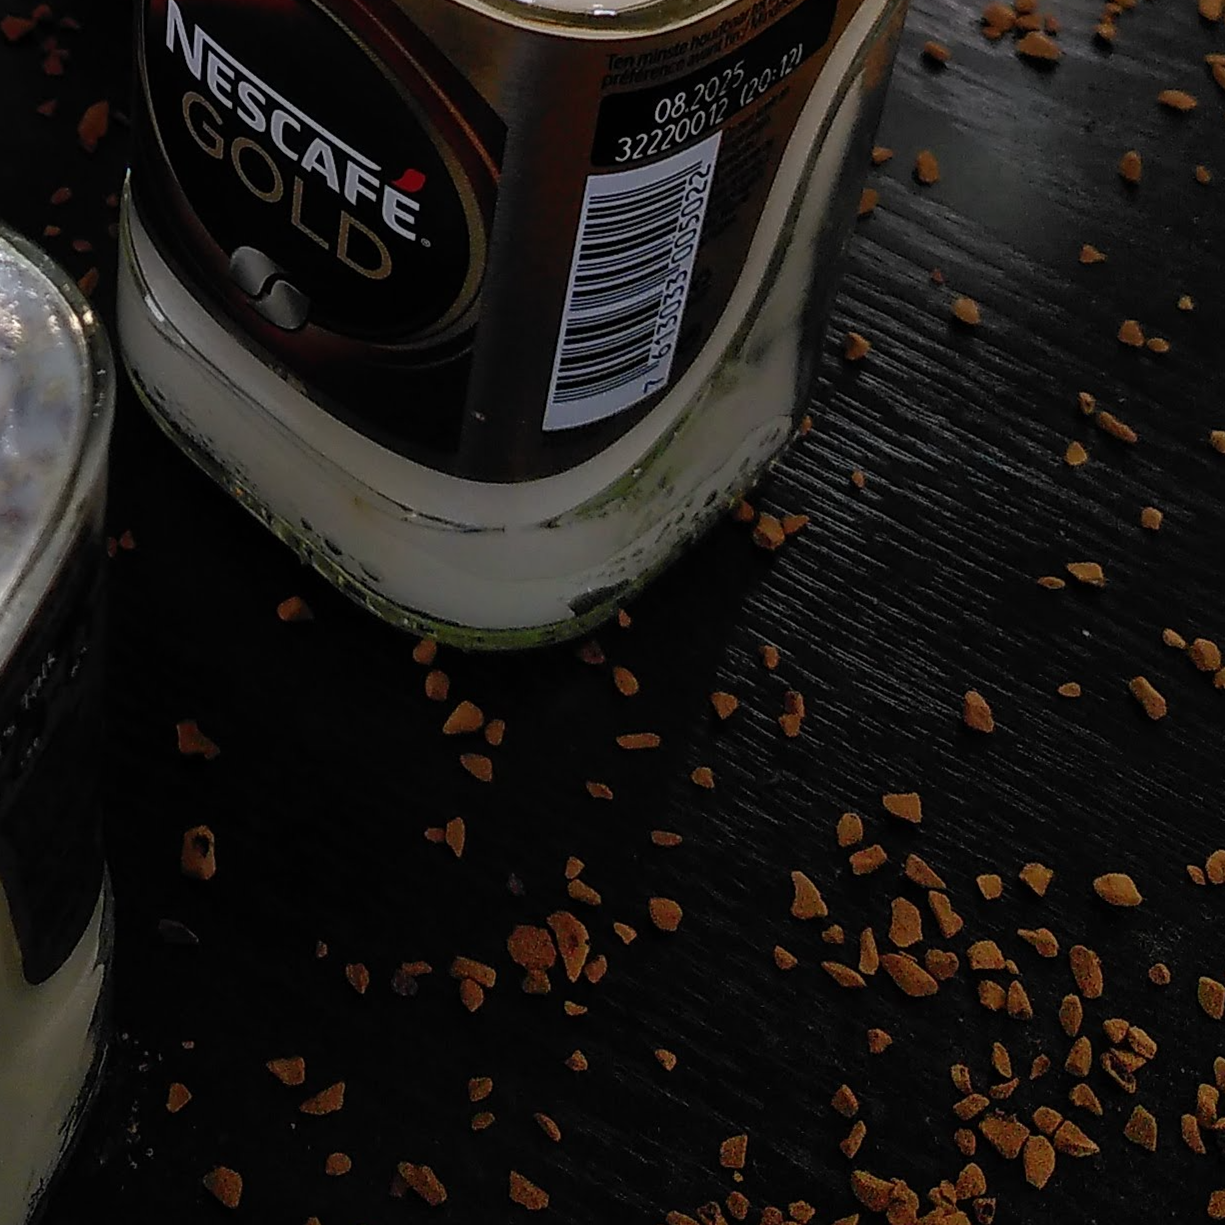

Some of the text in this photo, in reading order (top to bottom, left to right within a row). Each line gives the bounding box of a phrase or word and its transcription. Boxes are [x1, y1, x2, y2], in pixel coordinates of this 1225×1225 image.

[614, 96, 730, 163] 32220012
[654, 59, 746, 125] 08.2025
[181, 91, 393, 280] GOLD
[671, 163, 712, 266] 005022
